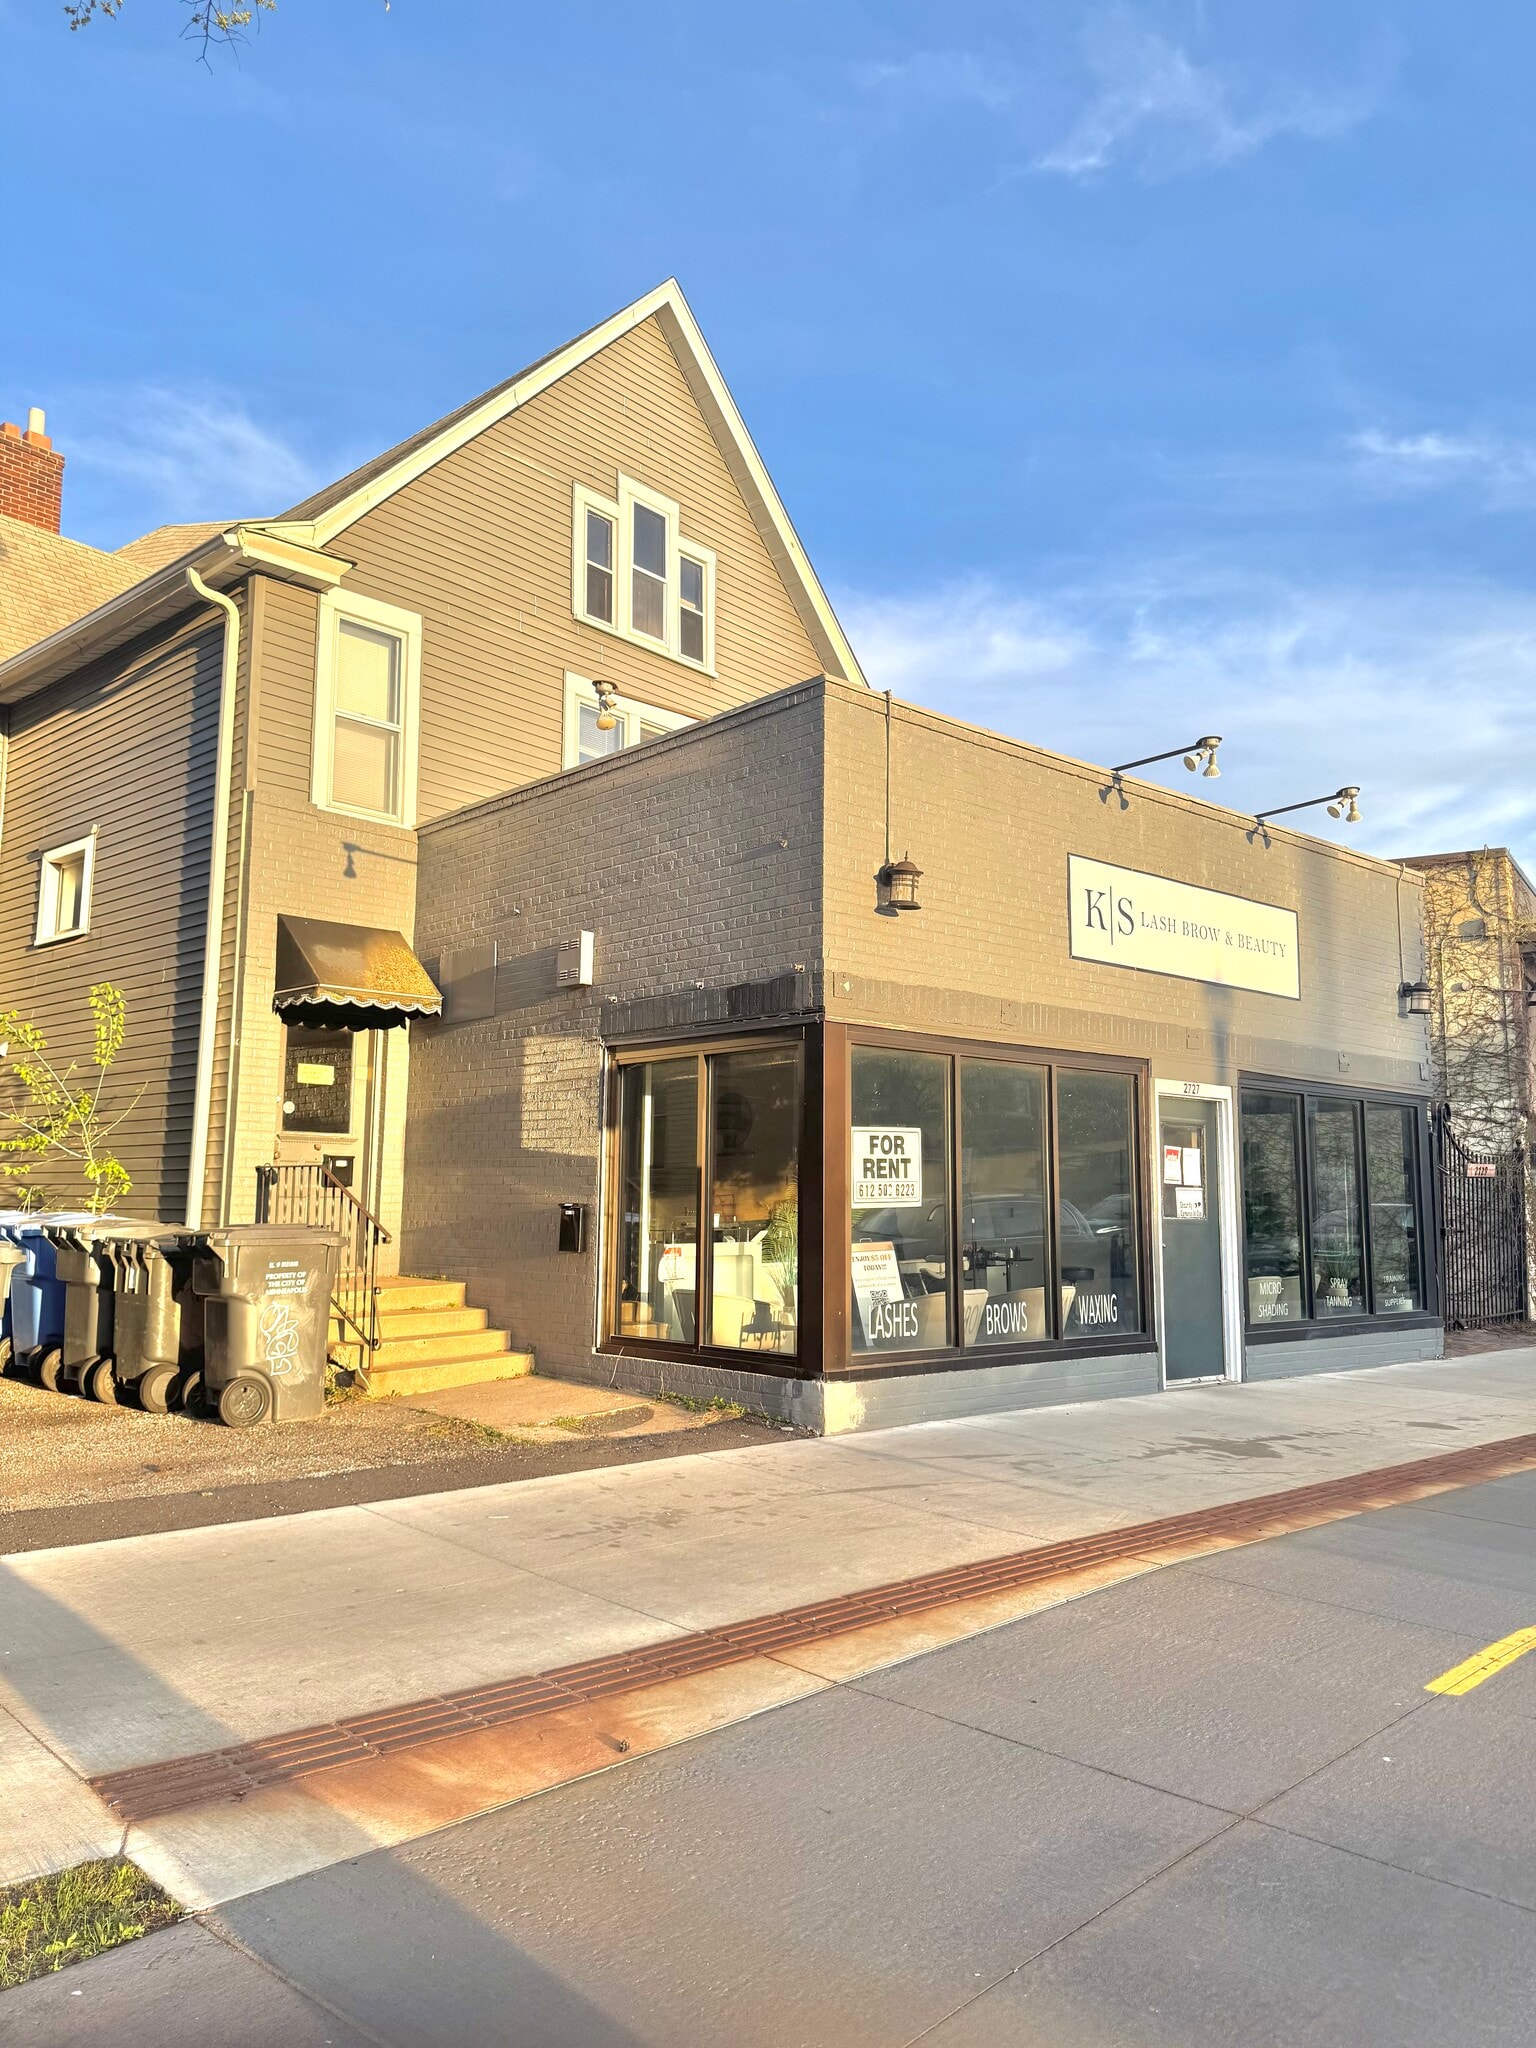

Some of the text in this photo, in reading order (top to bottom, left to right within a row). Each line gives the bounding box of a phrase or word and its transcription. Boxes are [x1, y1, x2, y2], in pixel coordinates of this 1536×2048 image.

[1141, 911, 1177, 934] LASH
[1182, 920, 1220, 942] BROW
[1225, 931, 1233, 946] &
[1238, 933, 1287, 958] BEAUTY
[1184, 1083, 1200, 1094] 2727
[869, 1135, 905, 1155] FOR
[863, 1158, 911, 1179] RENT
[859, 1184, 875, 1197] 612
[895, 1183, 915, 1197] 6223
[265, 1271, 307, 1280] PROPERTY OF
[281, 1279, 296, 1287] CITY
[296, 1278, 306, 1286] OF
[1330, 1278, 1348, 1289] SPRAY
[1325, 1295, 1353, 1307] TANNING
[1078, 1293, 1118, 1325] WAXING
[1258, 1303, 1289, 1318] SHADING
[868, 1302, 919, 1340] LASHES
[986, 1301, 1028, 1335] BROWS
